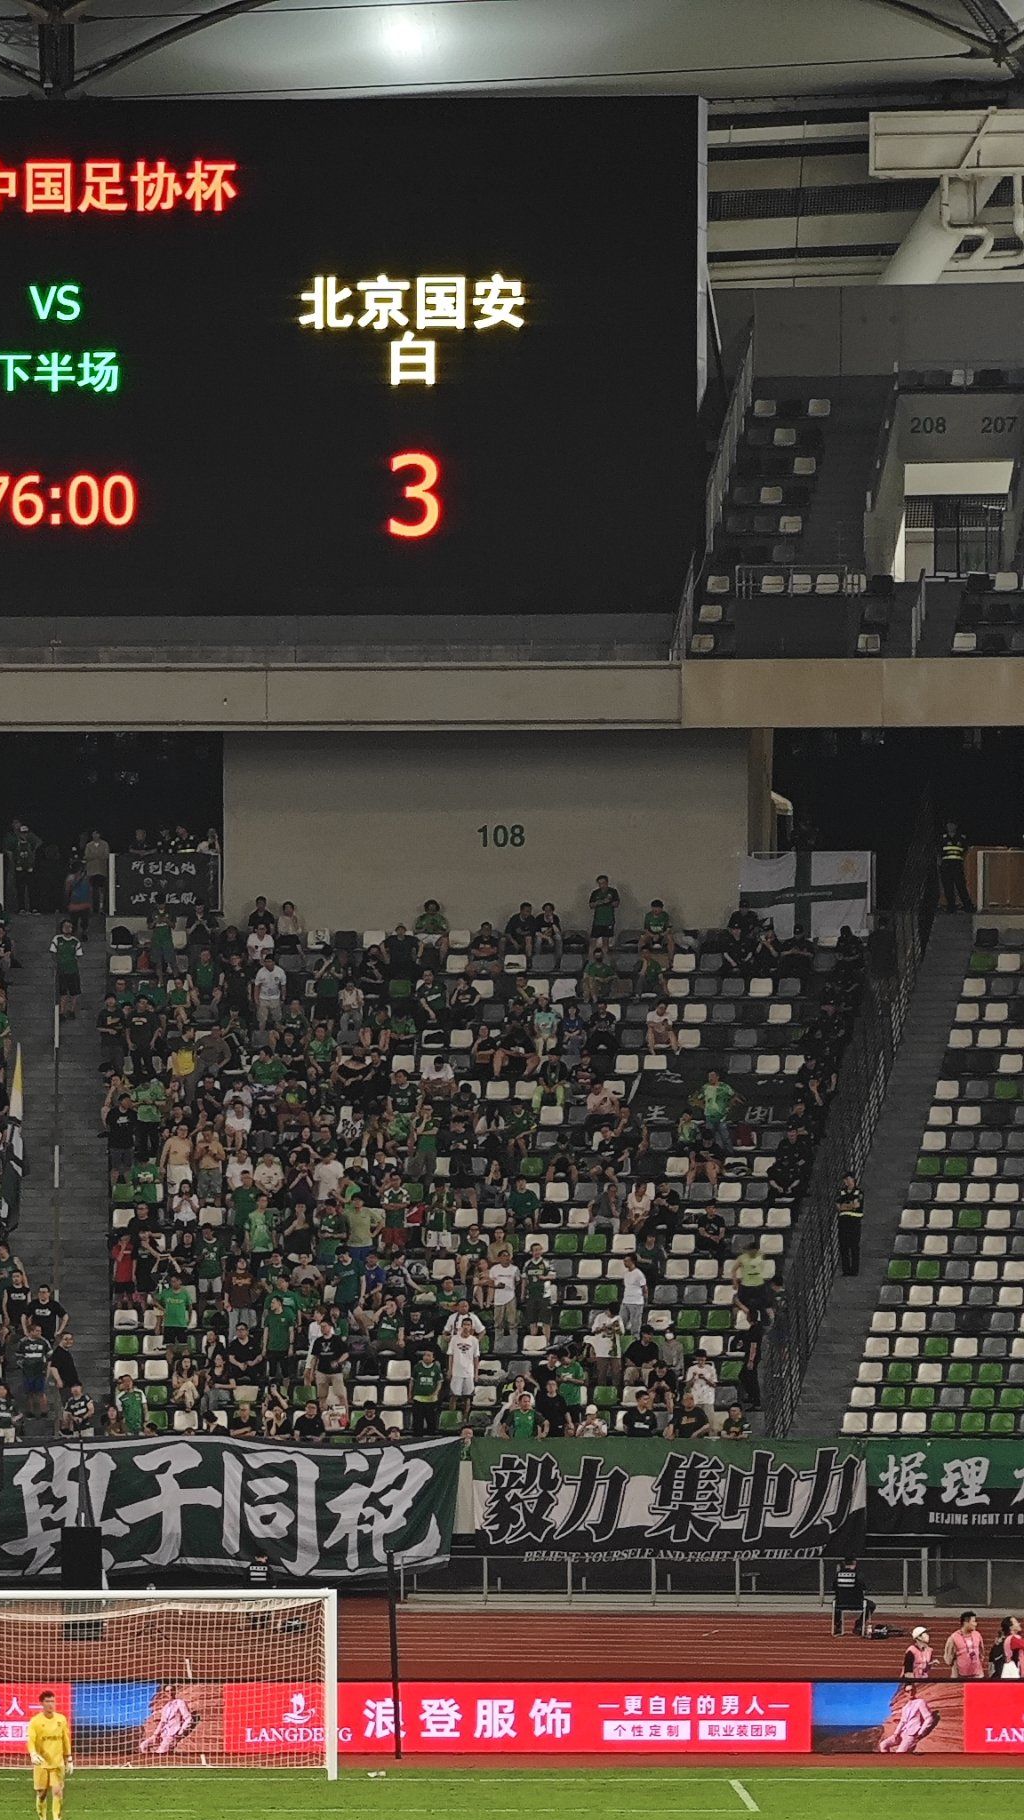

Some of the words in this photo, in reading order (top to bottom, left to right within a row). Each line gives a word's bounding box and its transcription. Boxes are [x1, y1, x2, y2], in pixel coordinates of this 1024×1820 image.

[29, 284, 81, 321] VS
[299, 273, 526, 330] 北京国安
[390, 331, 437, 386] 白
[910, 416, 947, 434] 208
[980, 416, 1018, 434] 207
[388, 453, 439, 538] 3
[477, 823, 526, 848] 108
[877, 1450, 1024, 1507] 据理
[482, 1452, 628, 1545] 毅力
[647, 1446, 861, 1544] 集中力
[928, 1511, 968, 1525] BEIJING
[971, 1512, 1000, 1526] FIGHT
[363, 1697, 572, 1739] 浪登服饰
[613, 1723, 679, 1738] 个性定制
[707, 1722, 778, 1738] 职业装团购
[245, 1727, 353, 1742] LANGDEG
